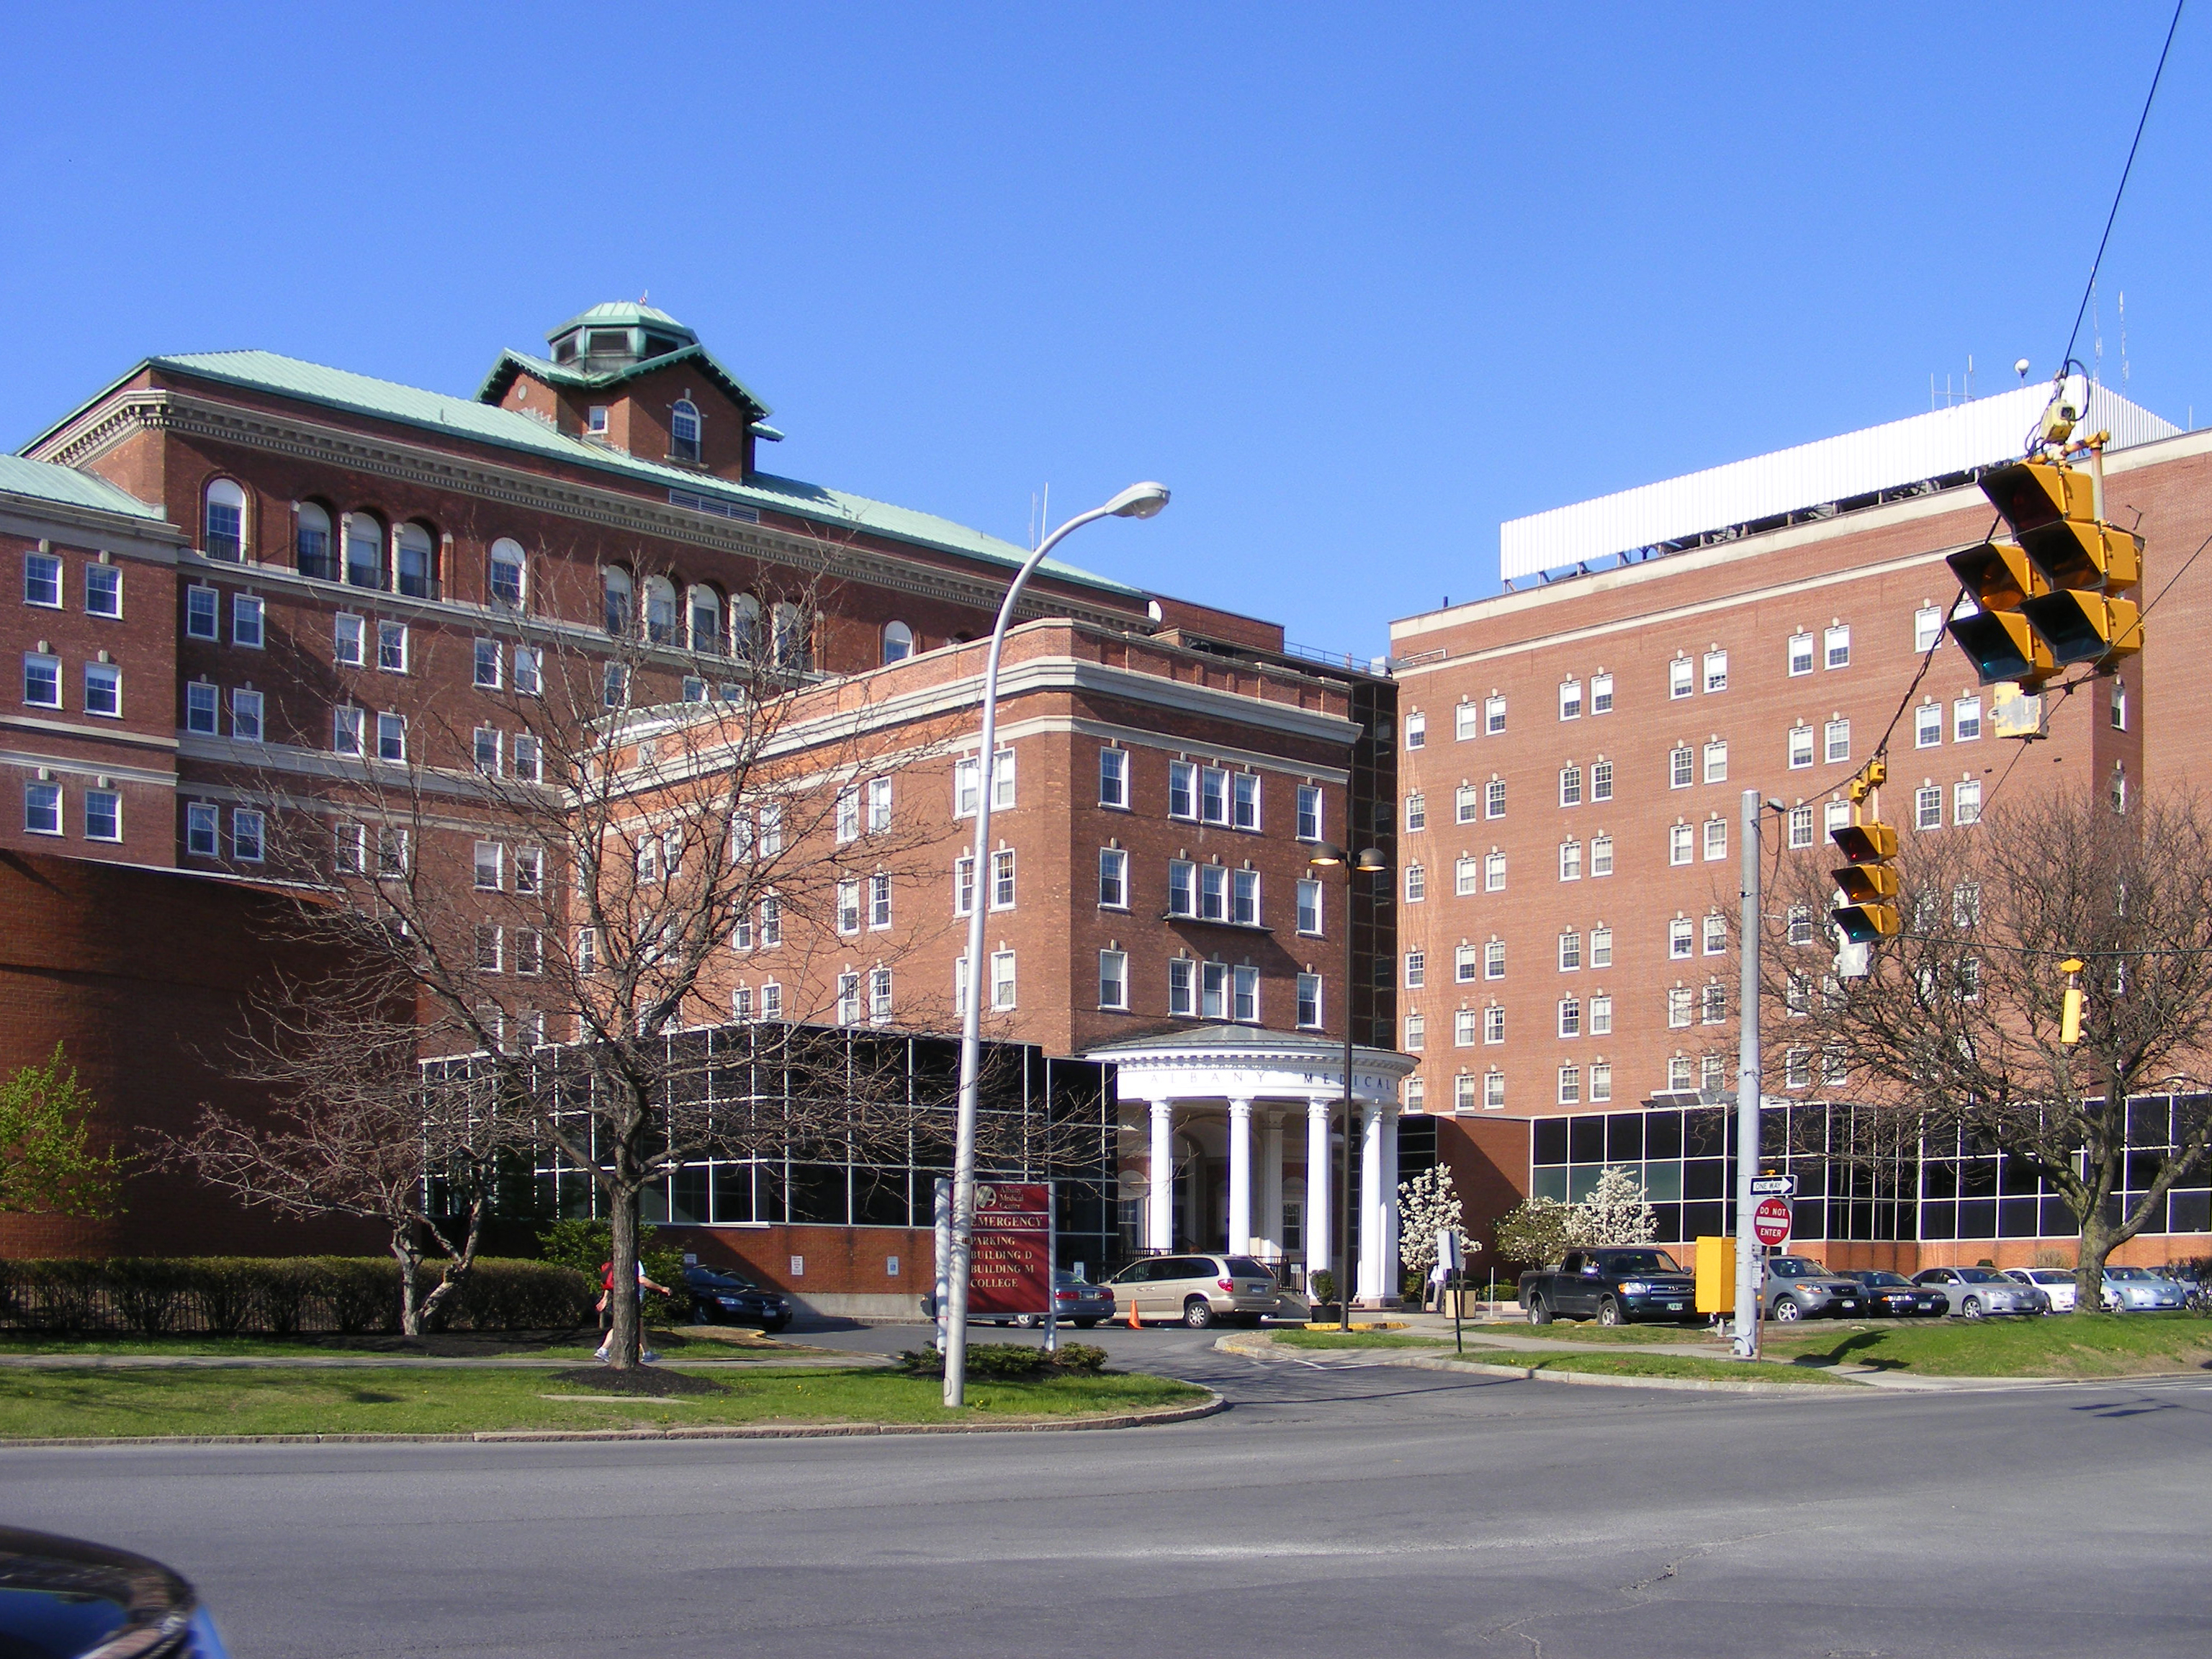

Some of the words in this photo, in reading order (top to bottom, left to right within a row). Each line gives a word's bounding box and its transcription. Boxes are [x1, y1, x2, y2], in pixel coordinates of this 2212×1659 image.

[1150, 1071, 1266, 1084] ALBANY
[1304, 1072, 1390, 1090] MEDICAL
[1760, 1206, 1770, 1215] DO
[1772, 1208, 1786, 1216] NOT
[1761, 1228, 1781, 1237] ENTER
[970, 1236, 1015, 1246] PARKING
[971, 1250, 1021, 1260] BUILDING
[1025, 1250, 1033, 1260] D
[971, 1264, 1021, 1274] BUILDING
[1025, 1264, 1034, 1274] M
[970, 1278, 1018, 1288] COLLEGE
